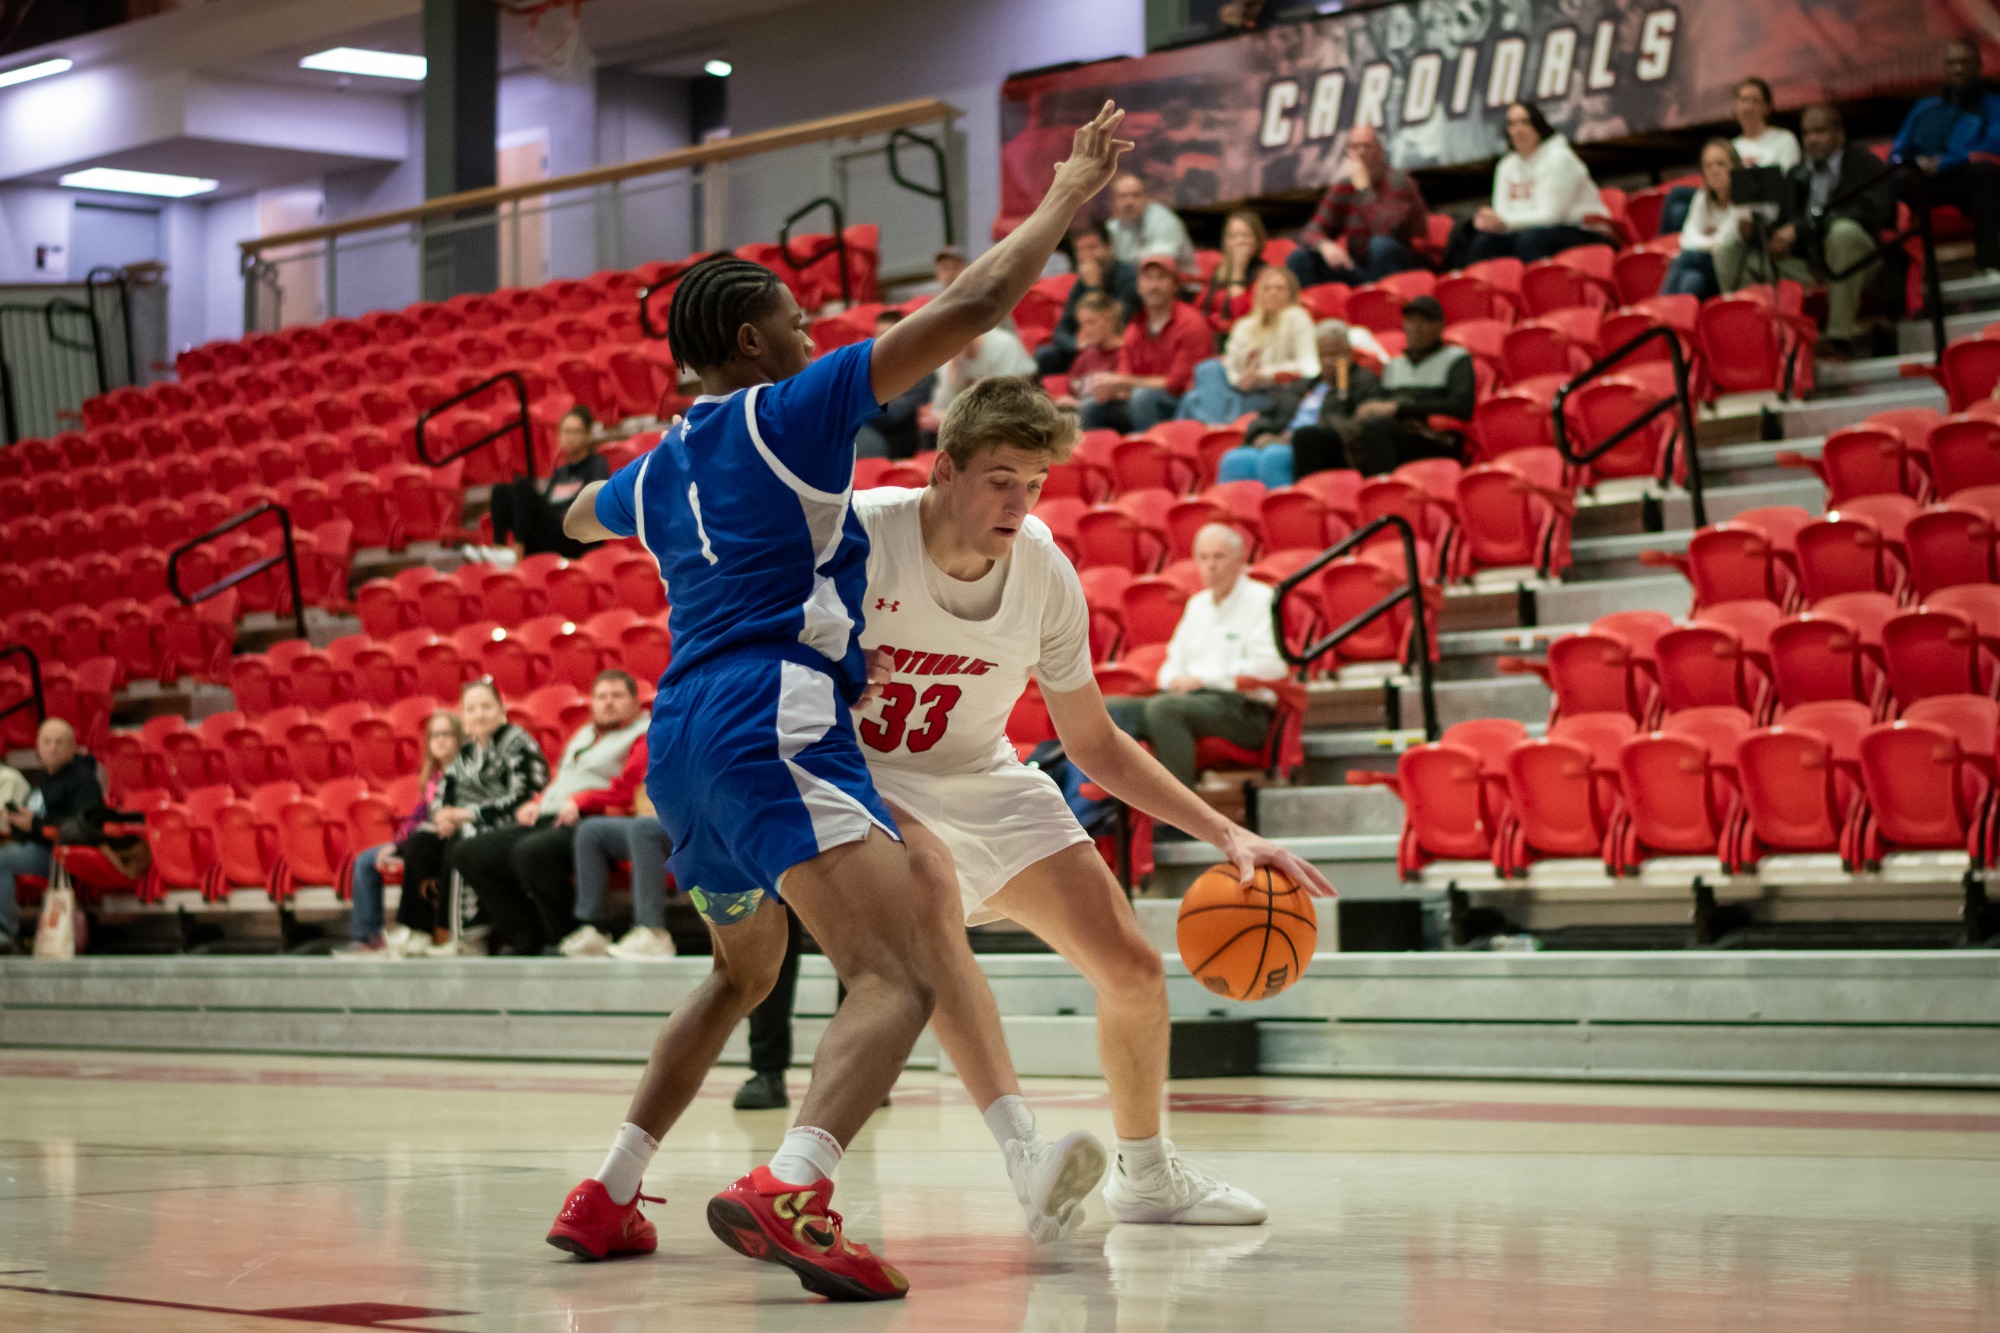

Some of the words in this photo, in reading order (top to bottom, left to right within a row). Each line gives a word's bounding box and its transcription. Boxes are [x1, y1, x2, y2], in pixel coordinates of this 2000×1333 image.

[1260, 8, 1677, 147] CARDINALS
[688, 481, 718, 566] 1
[859, 682, 962, 753] 33
